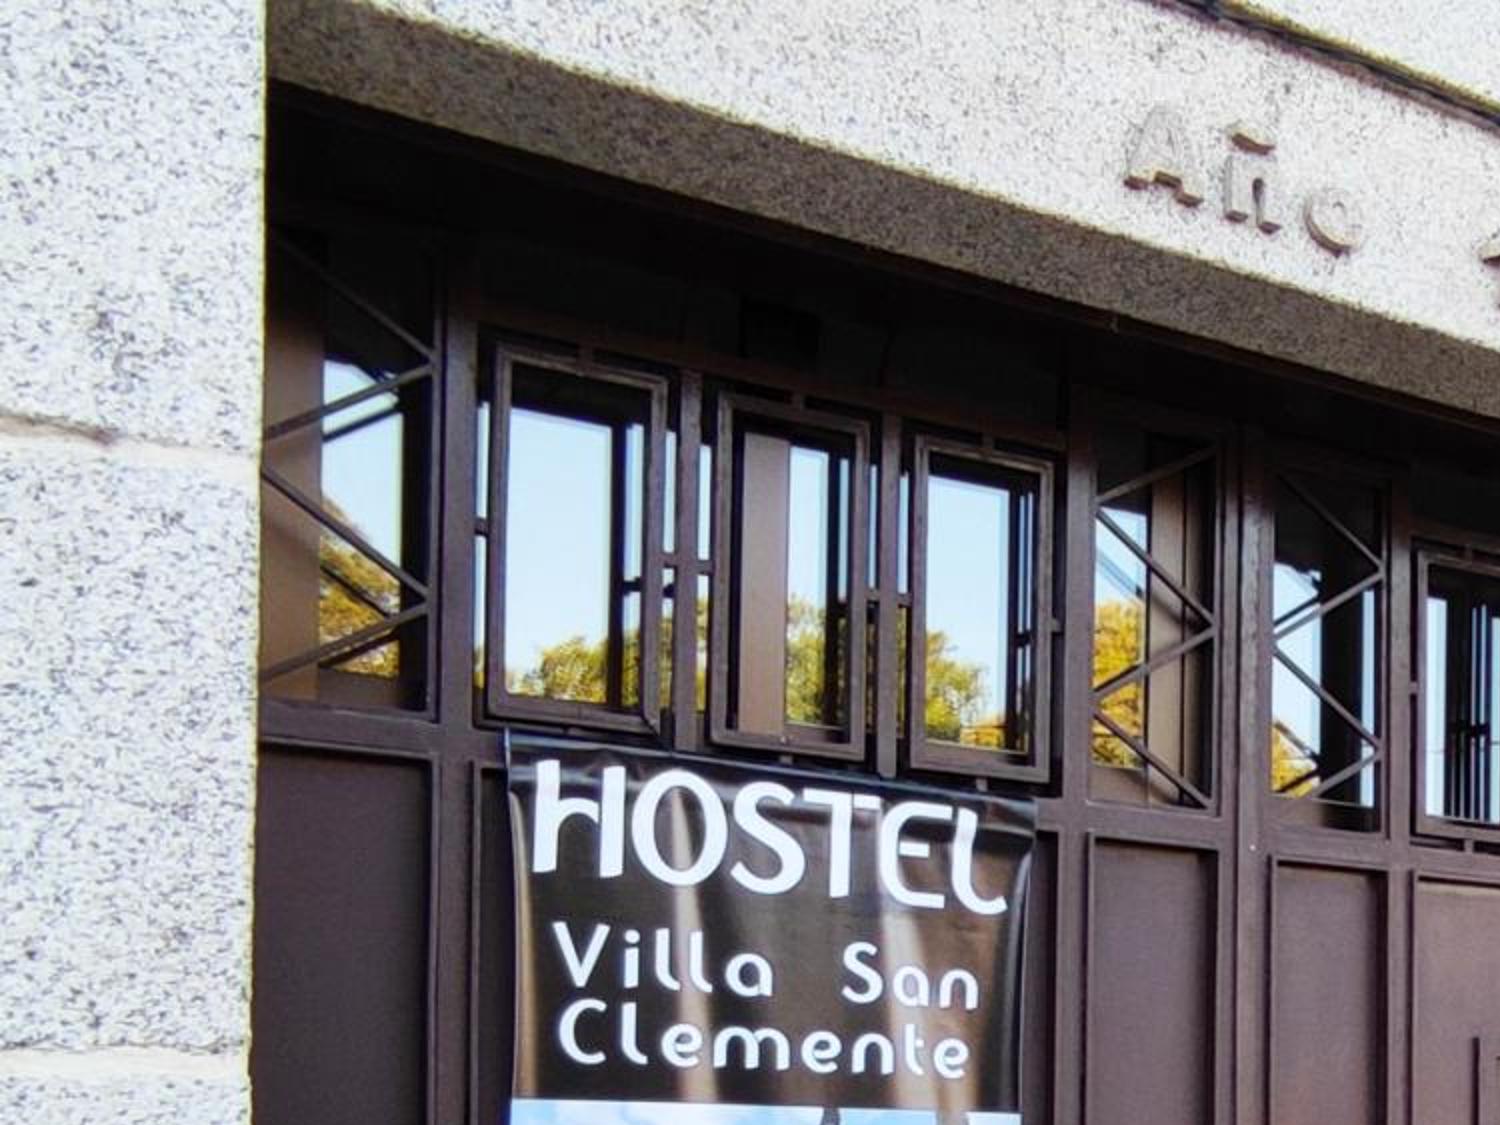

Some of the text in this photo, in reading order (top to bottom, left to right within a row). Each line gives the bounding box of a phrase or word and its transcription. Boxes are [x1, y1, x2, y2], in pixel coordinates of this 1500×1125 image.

[532, 758, 1009, 915] HOSTEL
[552, 921, 979, 1010] Villa San
[557, 998, 971, 1080] Clemente
